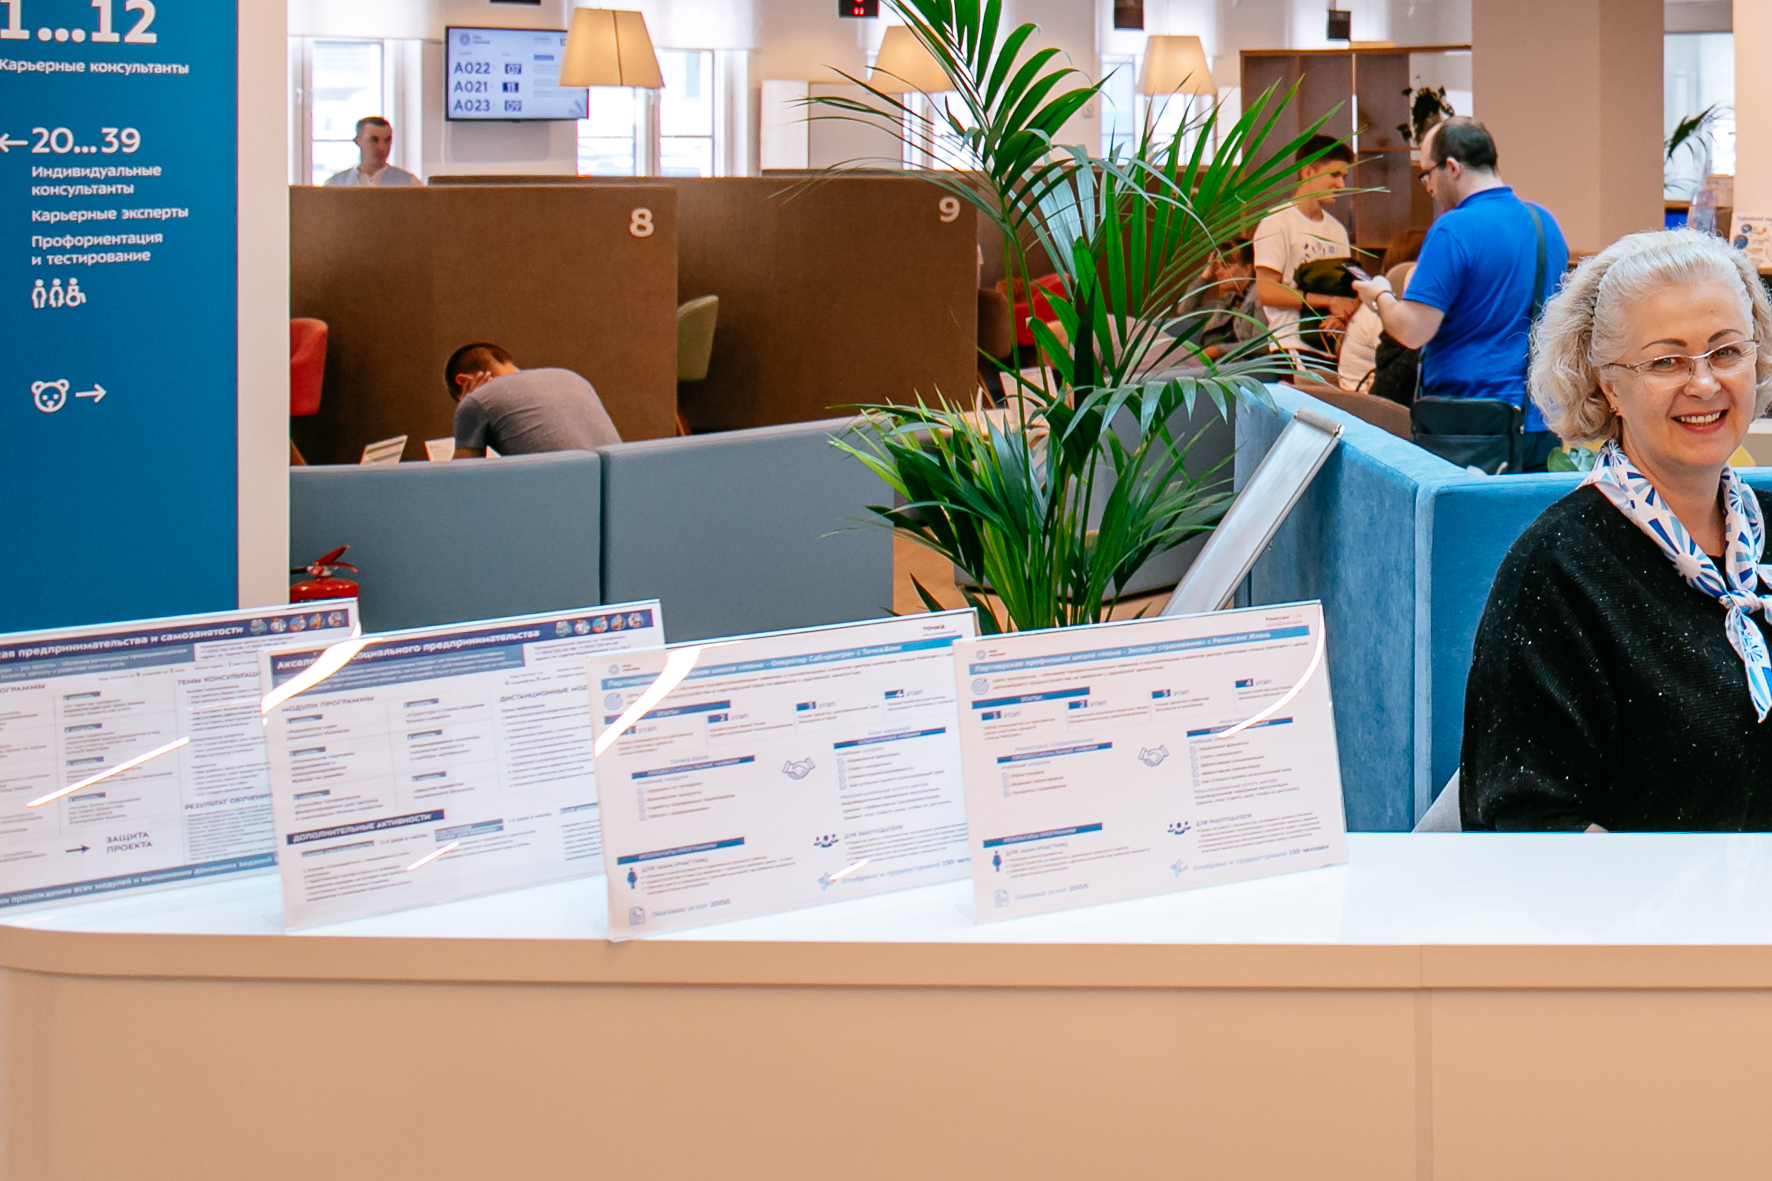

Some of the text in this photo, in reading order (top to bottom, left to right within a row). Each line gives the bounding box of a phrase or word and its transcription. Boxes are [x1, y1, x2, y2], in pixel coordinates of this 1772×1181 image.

[0, 58, 190, 76] Карьерные консультанты
[31, 127, 141, 154] 20...39
[31, 163, 162, 180] Индивидуальные
[31, 182, 135, 198] консультанты
[31, 206, 189, 223] Карьерные эксперты
[938, 197, 960, 223] 9
[629, 208, 654, 238] 8
[31, 231, 164, 250] Профориентация
[31, 249, 151, 267] и тестирование
[18, 636, 148, 659] предпринимательства
[160, 626, 244, 642] самозанятости
[422, 629, 540, 653] предпринимательства
[203, 670, 261, 684] КОНСУЛЬТАЦИ
[320, 695, 374, 708] ПРОГРАММЫ
[185, 798, 227, 811] РЕЗУЛЬТАТ
[106, 832, 149, 844] ЗАЩИТА
[293, 822, 375, 843] ДОПОЛНИТЕЛЬНЫЕ
[106, 841, 153, 854] ПРОЕКТА
